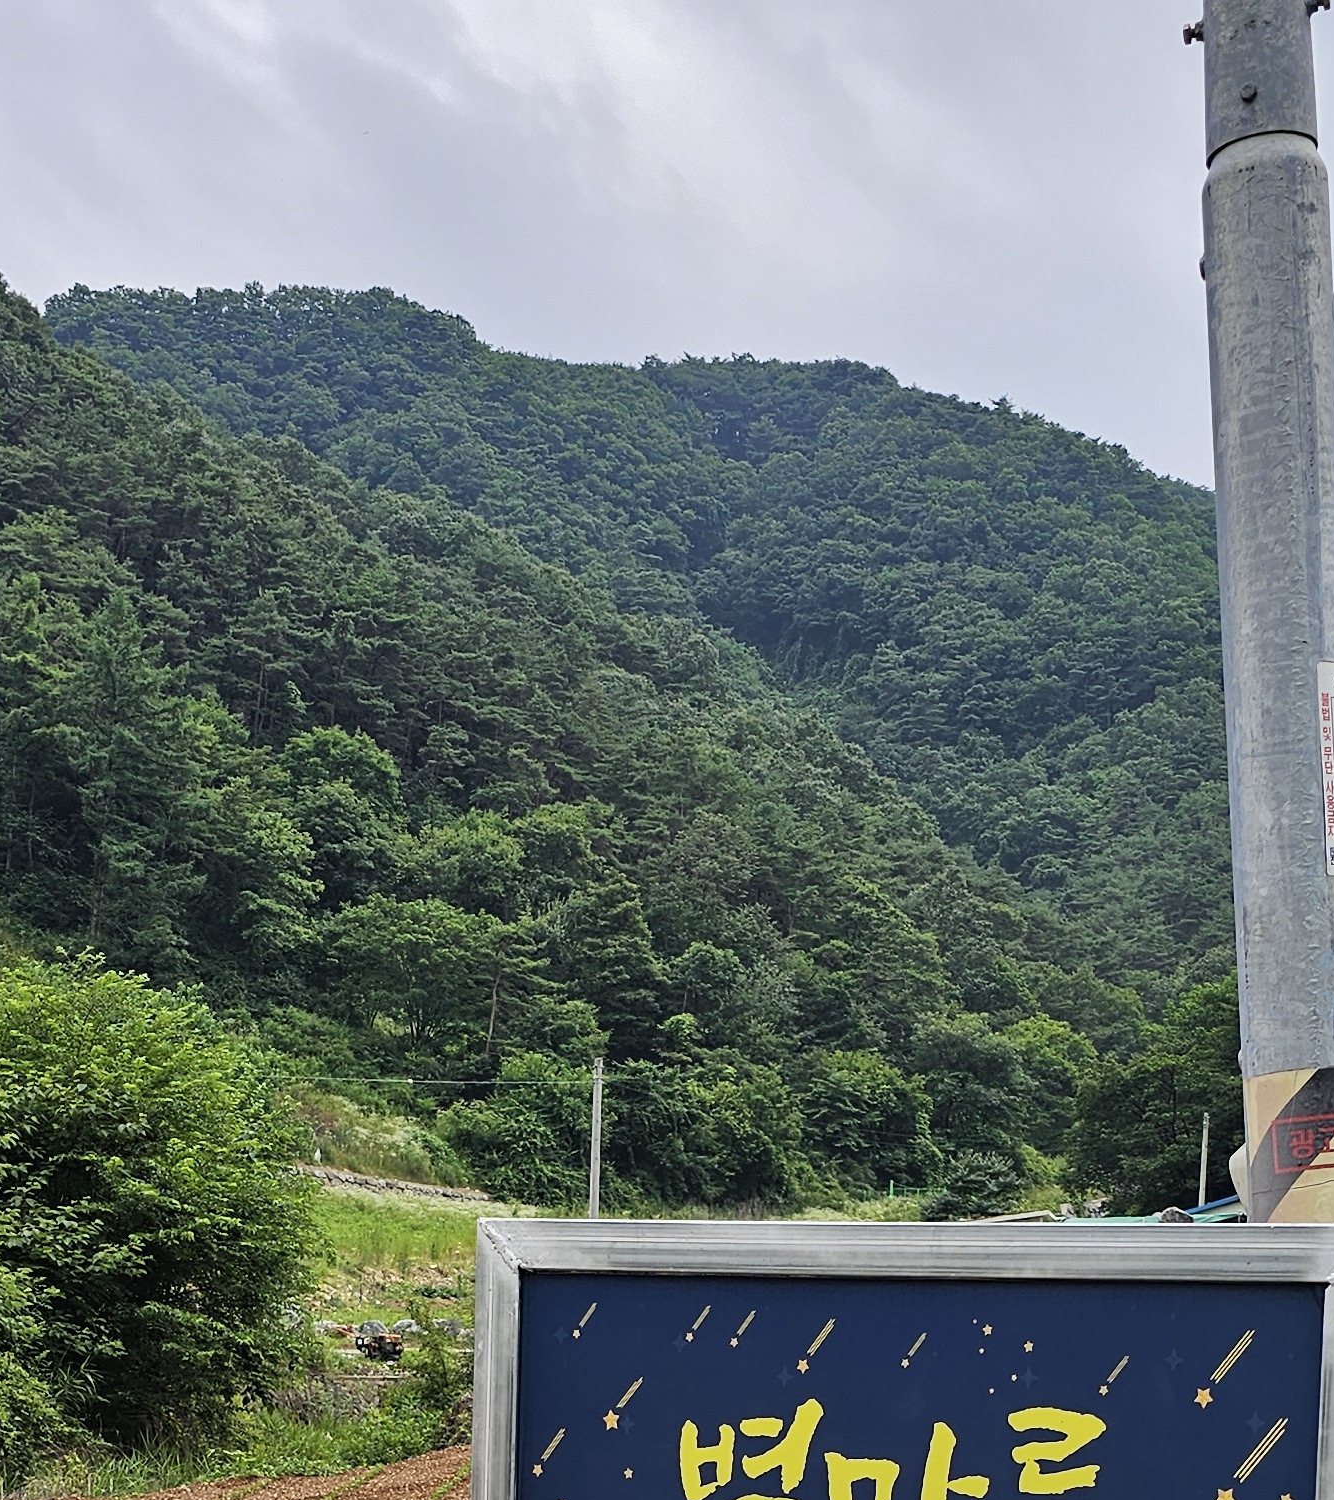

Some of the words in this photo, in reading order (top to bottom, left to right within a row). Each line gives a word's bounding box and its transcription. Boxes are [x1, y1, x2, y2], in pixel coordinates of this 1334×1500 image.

[1321, 692, 1331, 721] 불법
[1323, 727, 1332, 741] 및
[1324, 747, 1333, 774] 무단
